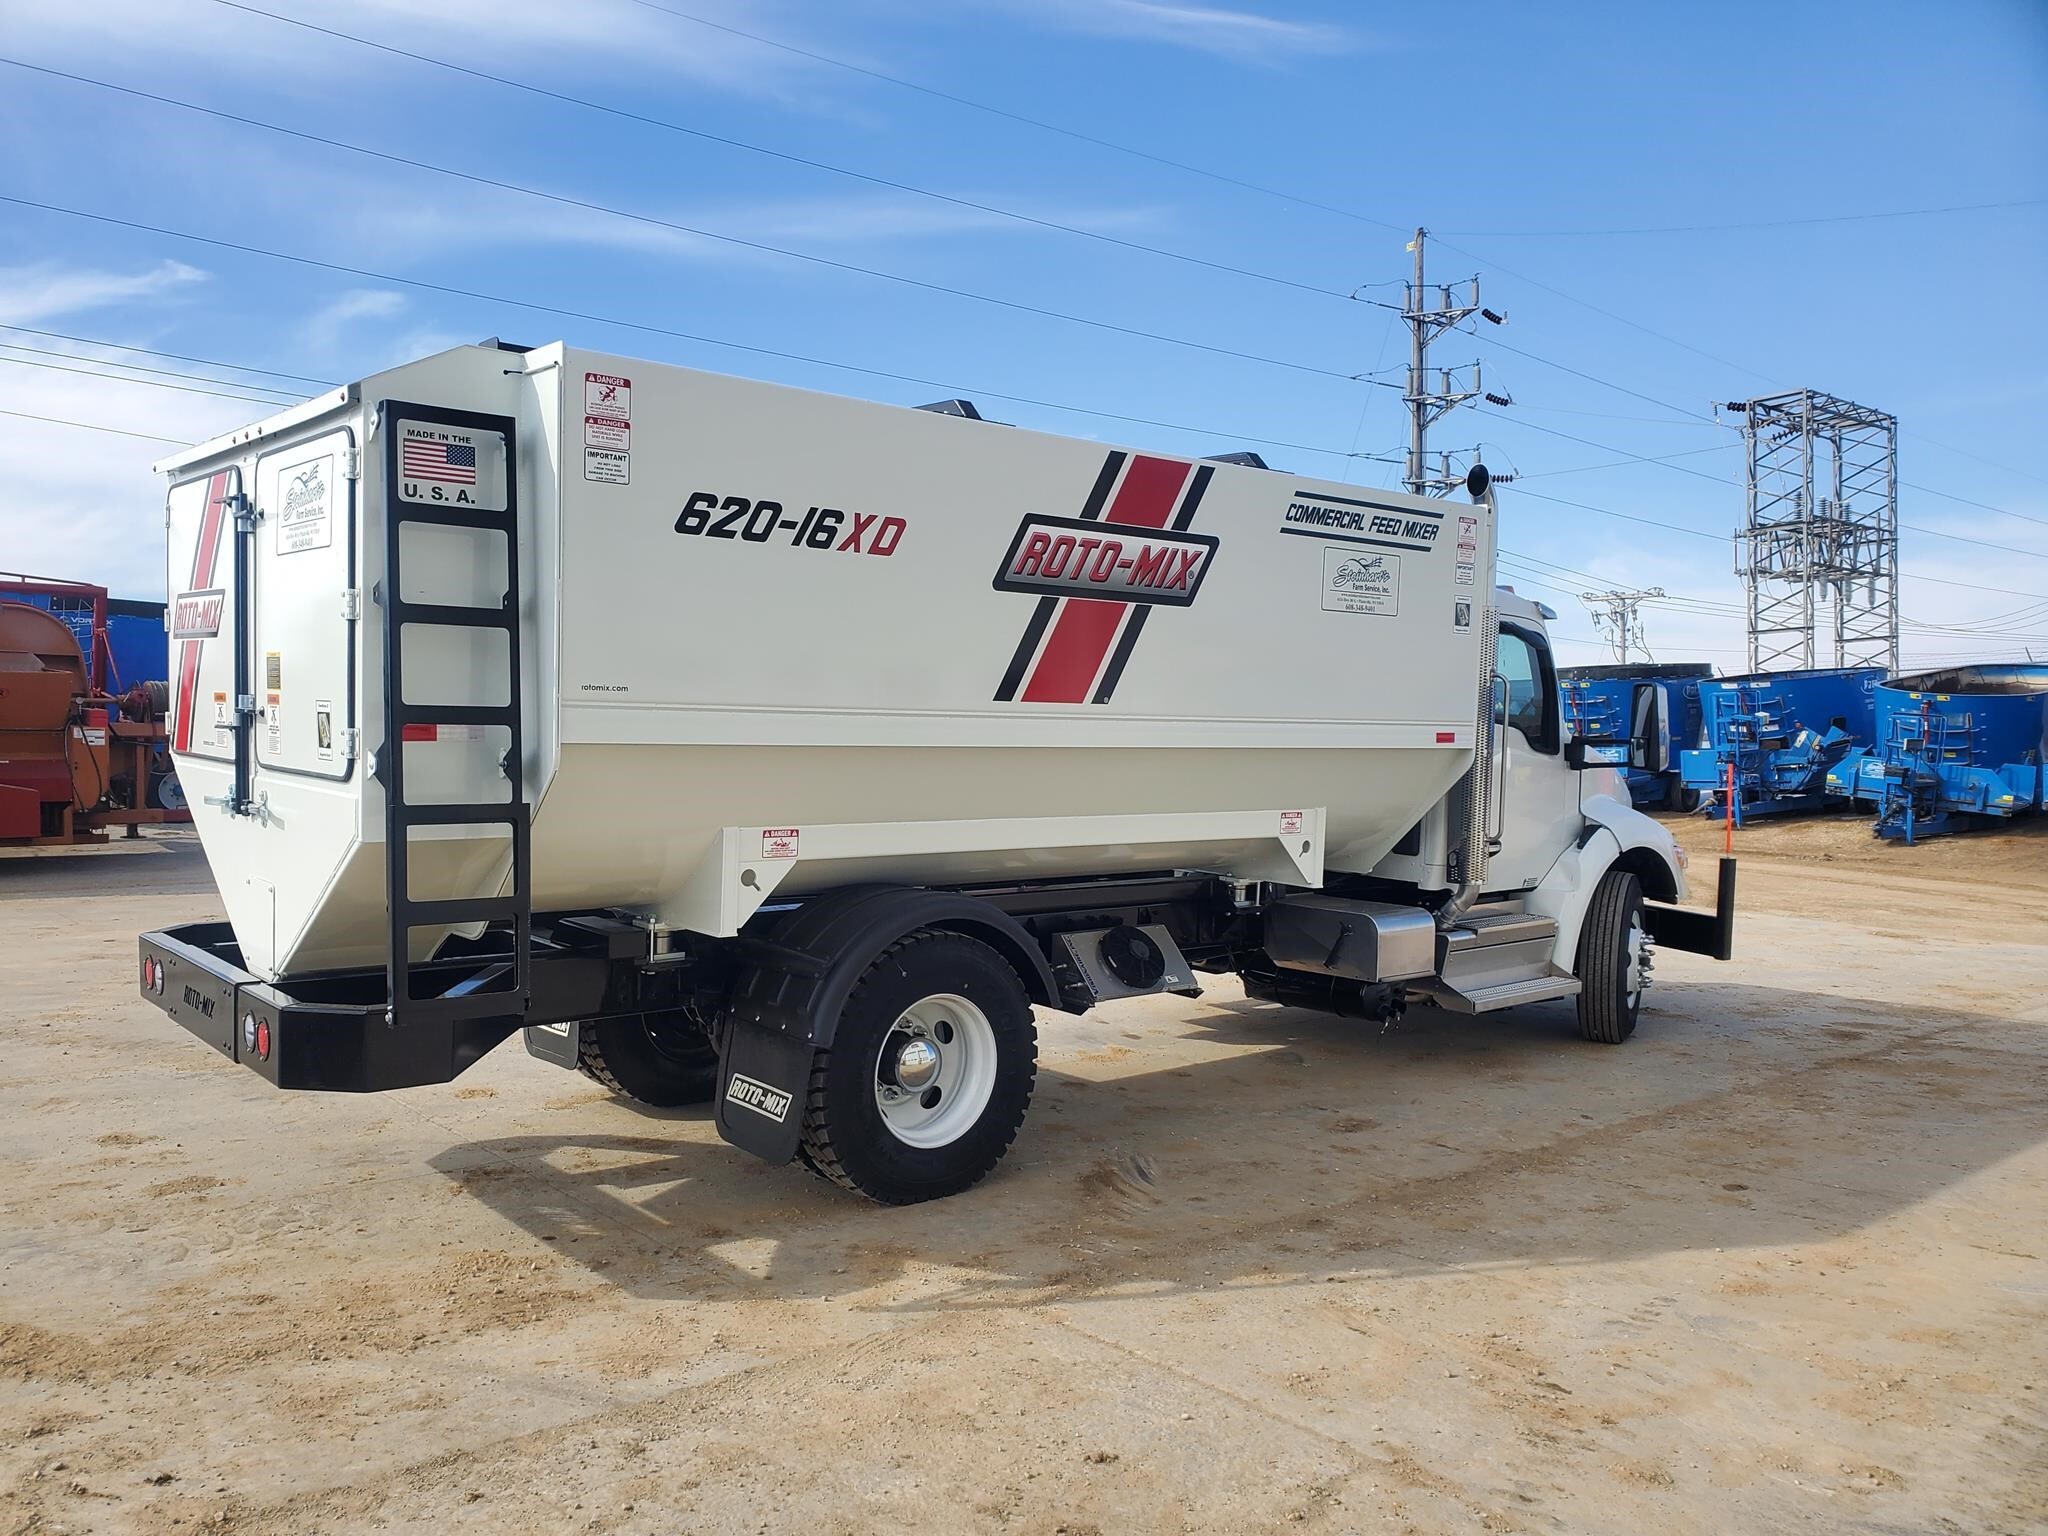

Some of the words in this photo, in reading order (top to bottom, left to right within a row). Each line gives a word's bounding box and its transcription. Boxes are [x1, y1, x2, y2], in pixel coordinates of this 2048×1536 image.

[596, 375, 625, 387] DANGER
[592, 429, 611, 437] MATERIALS
[597, 419, 625, 429] DANGER
[407, 429, 436, 439] MADE
[439, 433, 449, 442] IN
[452, 435, 472, 444] THE
[587, 450, 627, 462] IMPORTANT
[674, 491, 907, 557] 620-16XD
[1285, 503, 1365, 531] COMMERCIAL
[1368, 515, 1400, 536] FEED
[1401, 520, 1440, 541] MIXER
[1012, 530, 1203, 591] ROTO-MIX
[1333, 565, 1391, 587] Steinhart's
[1364, 584, 1380, 592] Service,
[176, 599, 220, 630] ROTO-MIX
[582, 684, 628, 692] rotomix.com
[183, 984, 215, 1020] ROTO-MIX
[731, 1080, 787, 1115] ROTO-MIX
